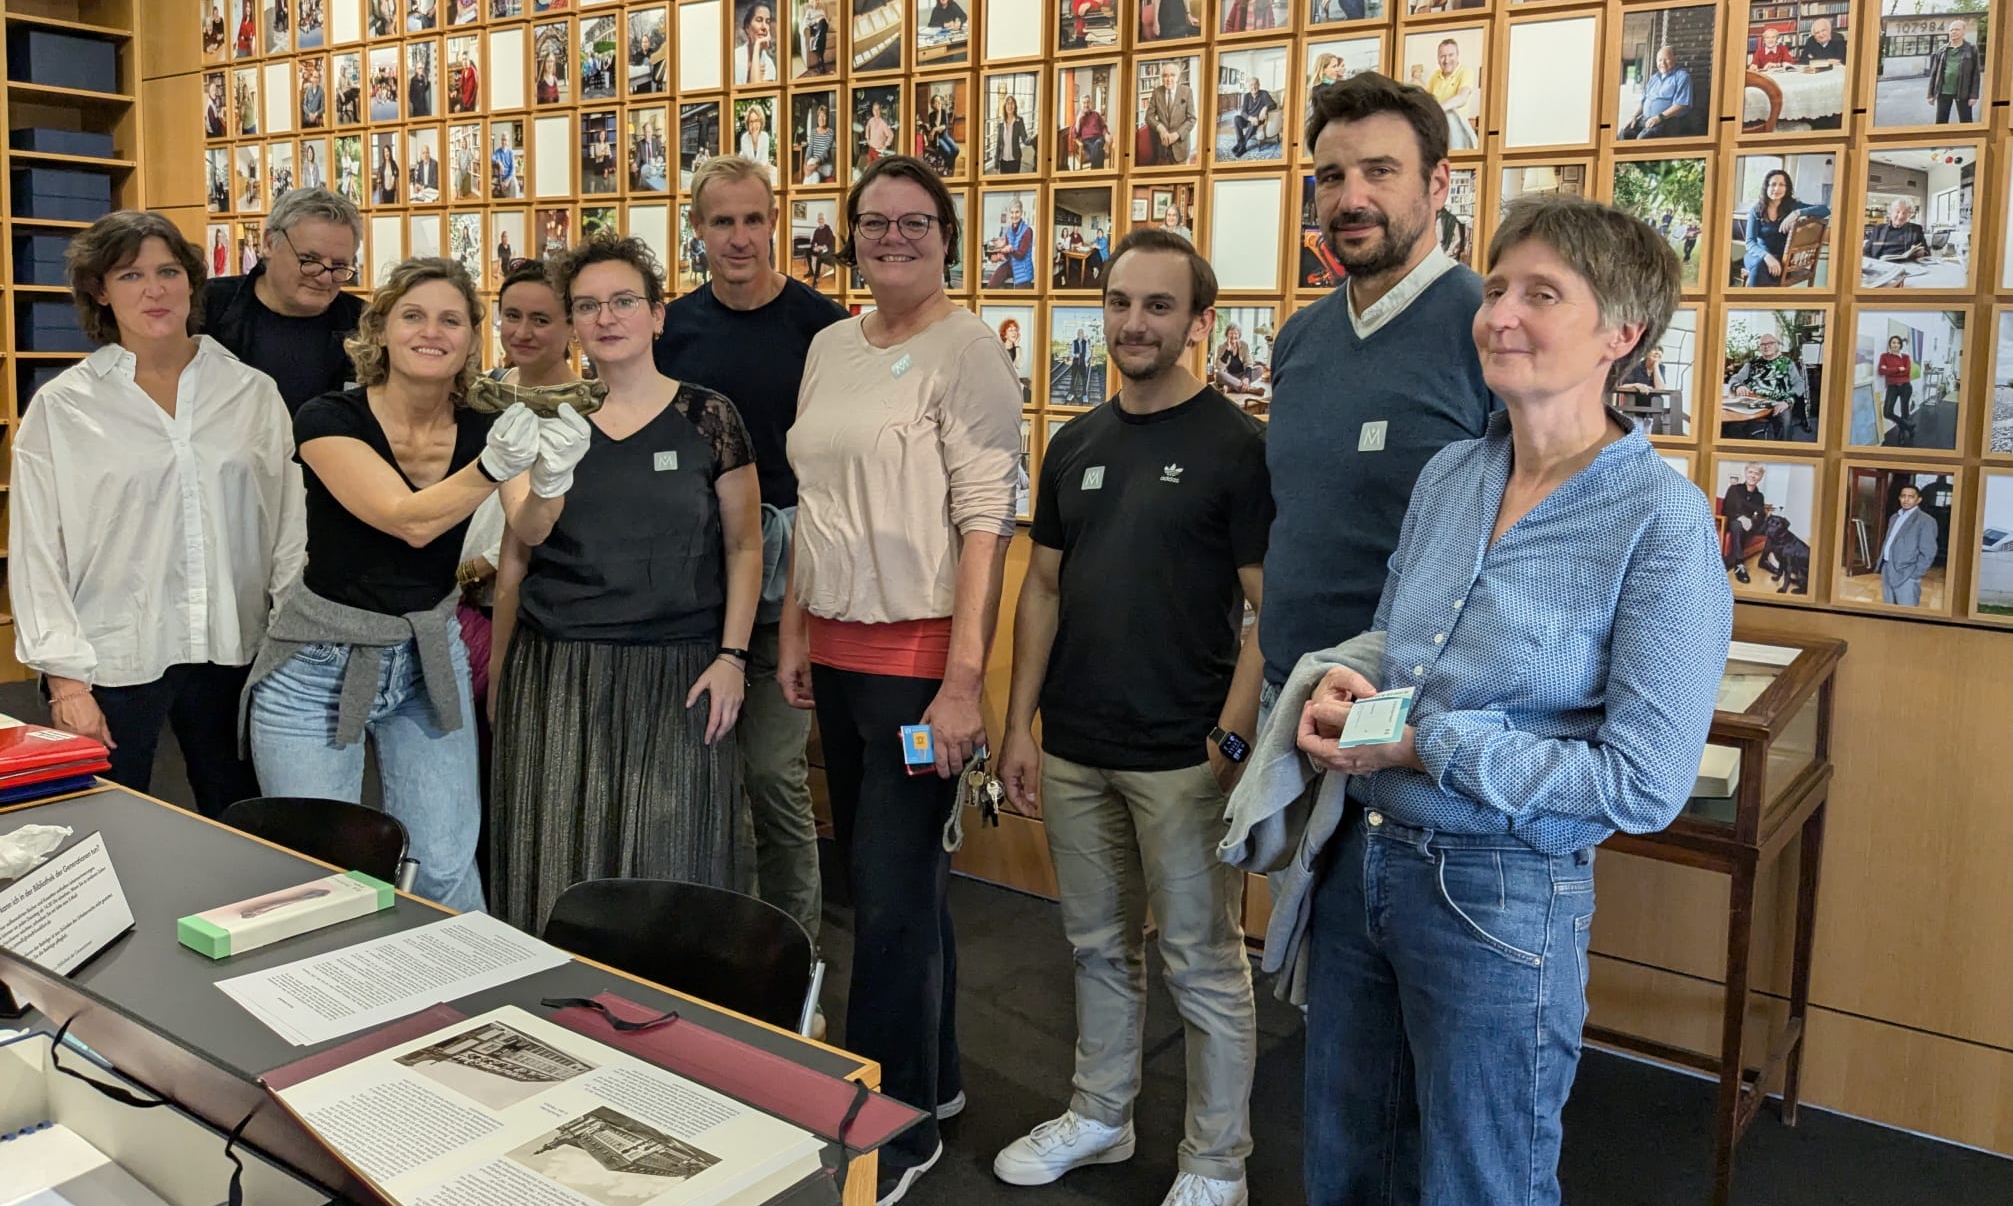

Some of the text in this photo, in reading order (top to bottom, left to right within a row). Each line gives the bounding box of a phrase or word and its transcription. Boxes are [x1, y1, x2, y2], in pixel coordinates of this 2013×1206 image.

[1895, 21, 1945, 34] 107984
[1159, 476, 1180, 484] adidas
[25, 889, 33, 897] der
[32, 873, 55, 892] Bibliothek
[55, 870, 63, 878] der
[62, 852, 91, 872] Generationen
